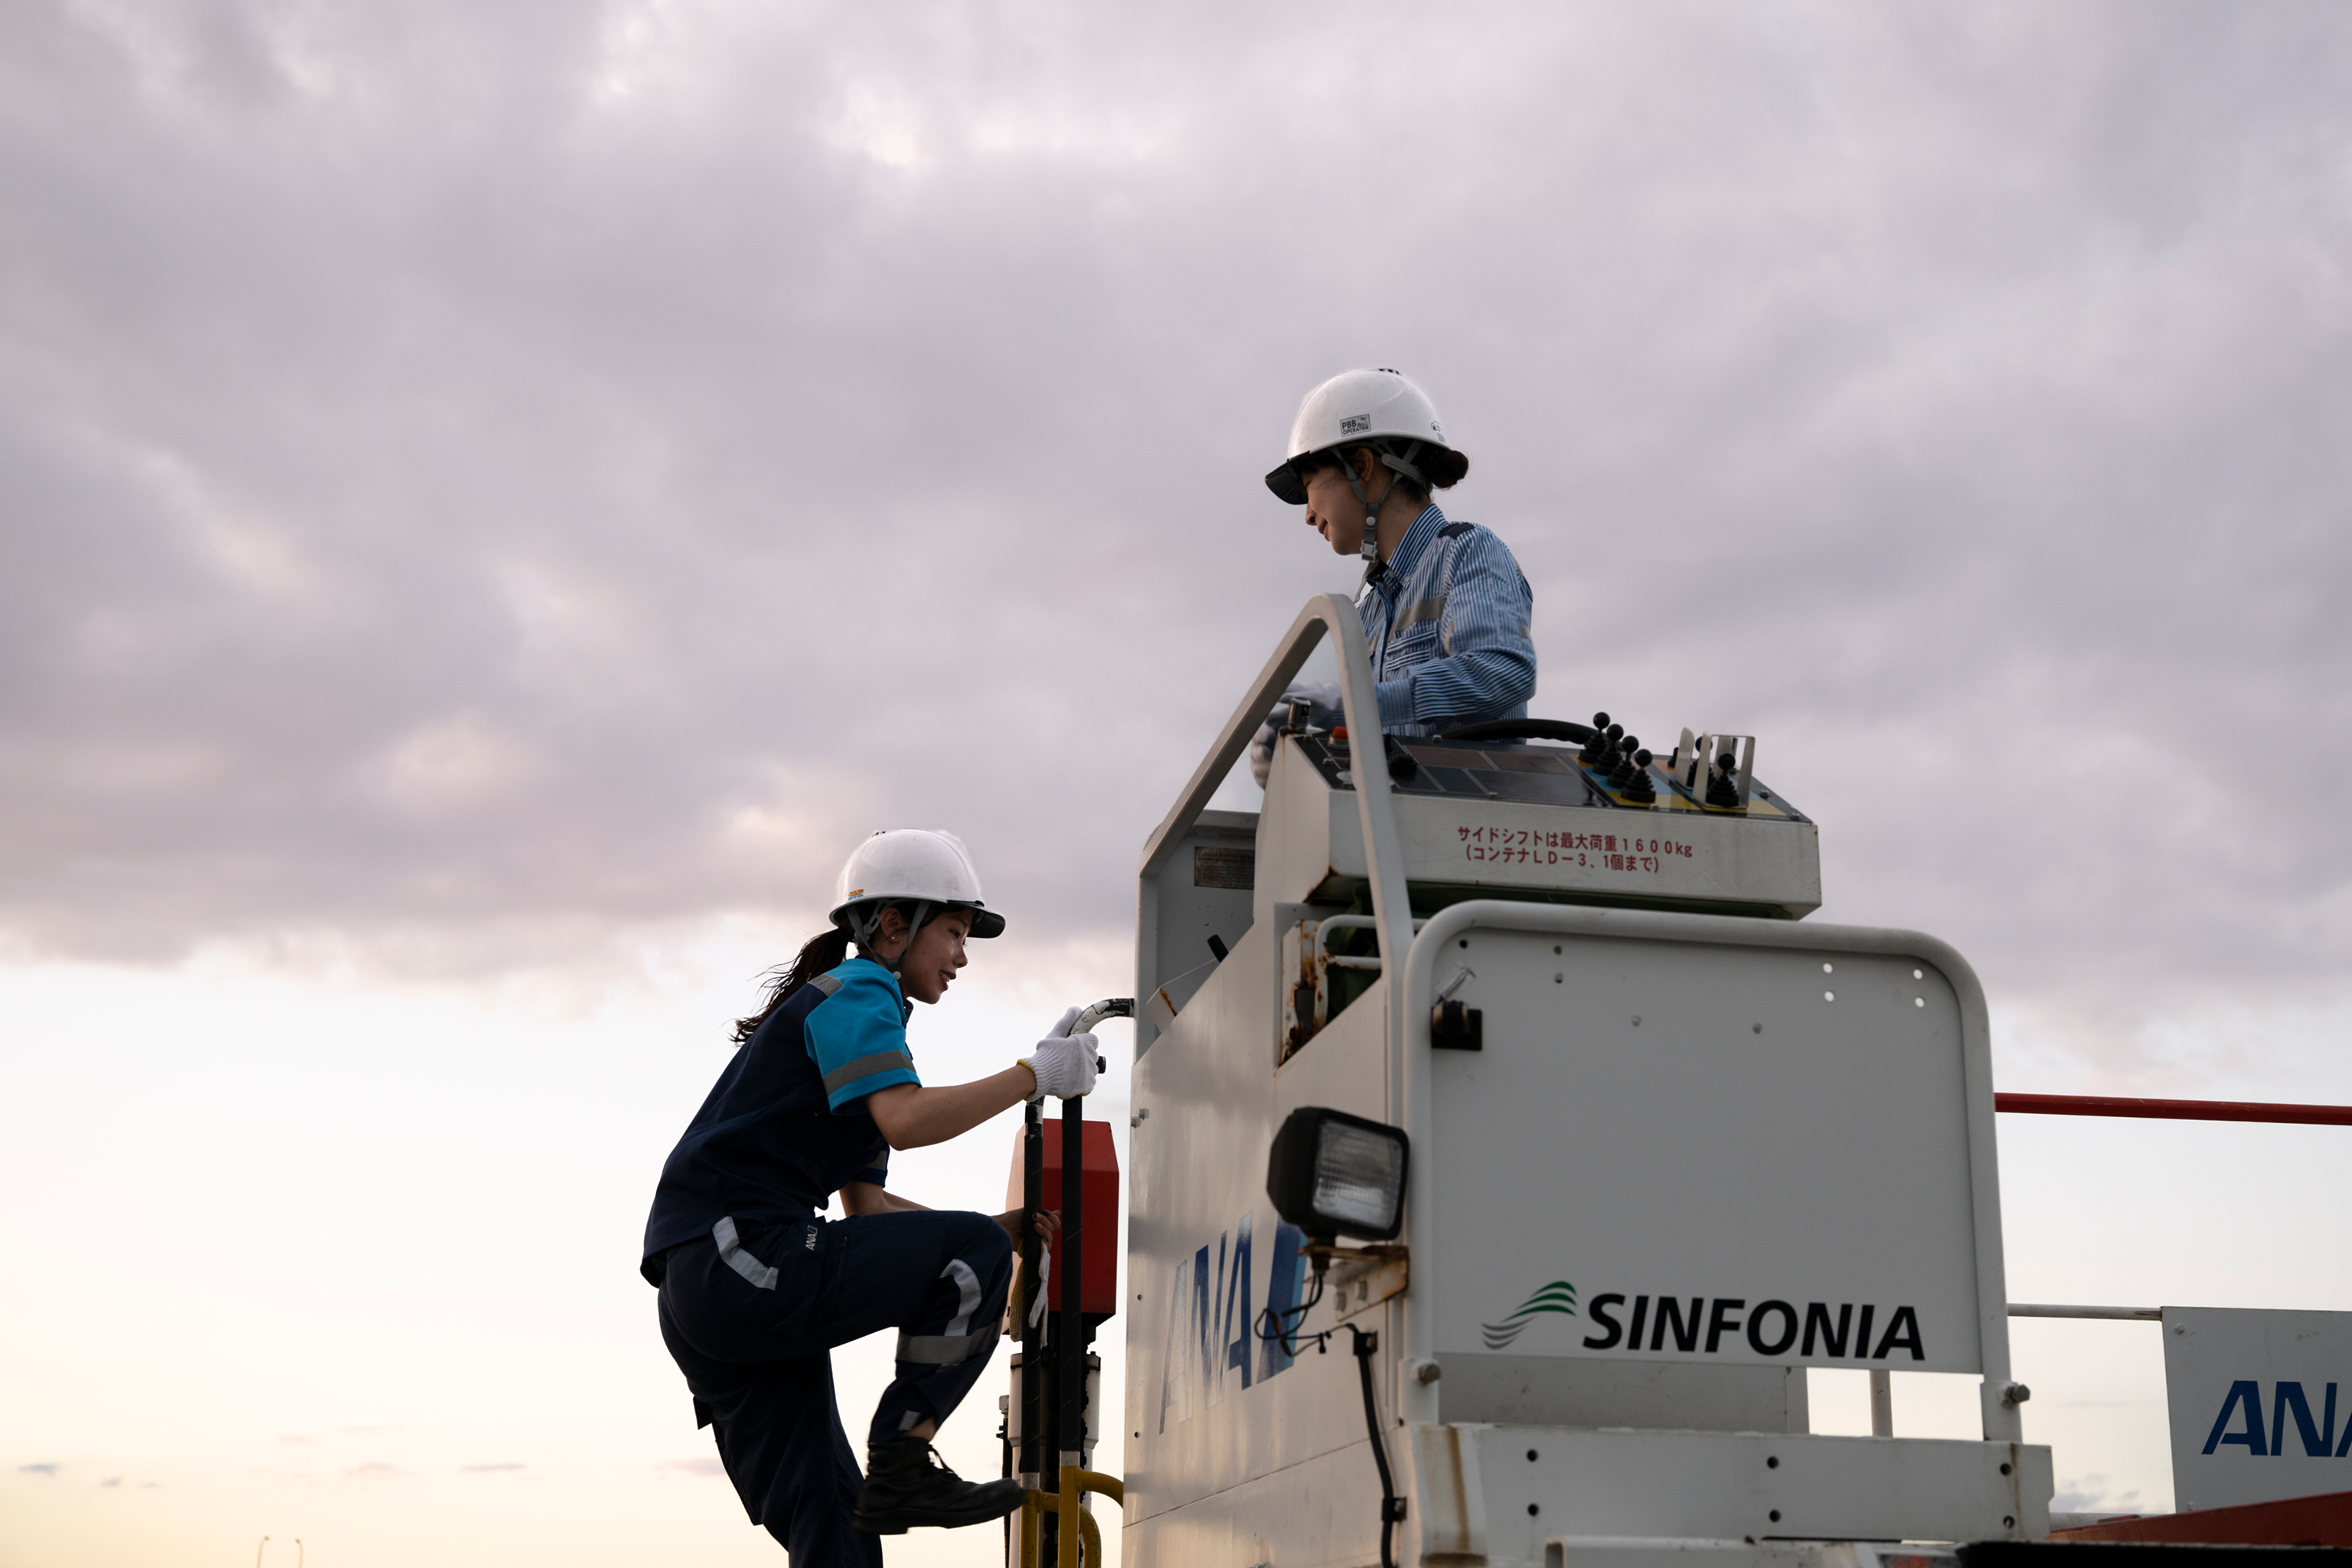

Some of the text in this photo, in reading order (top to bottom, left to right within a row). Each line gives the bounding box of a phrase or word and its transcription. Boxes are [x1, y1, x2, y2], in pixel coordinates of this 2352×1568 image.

[1341, 420, 1357, 430] PBB
[1343, 426, 1369, 435] OPERATOR
[805, 1233, 818, 1250] ANA
[1158, 1210, 1253, 1435] ANA
[1582, 1293, 1926, 1361] SINFONIA
[2201, 1380, 2352, 1458] AN
